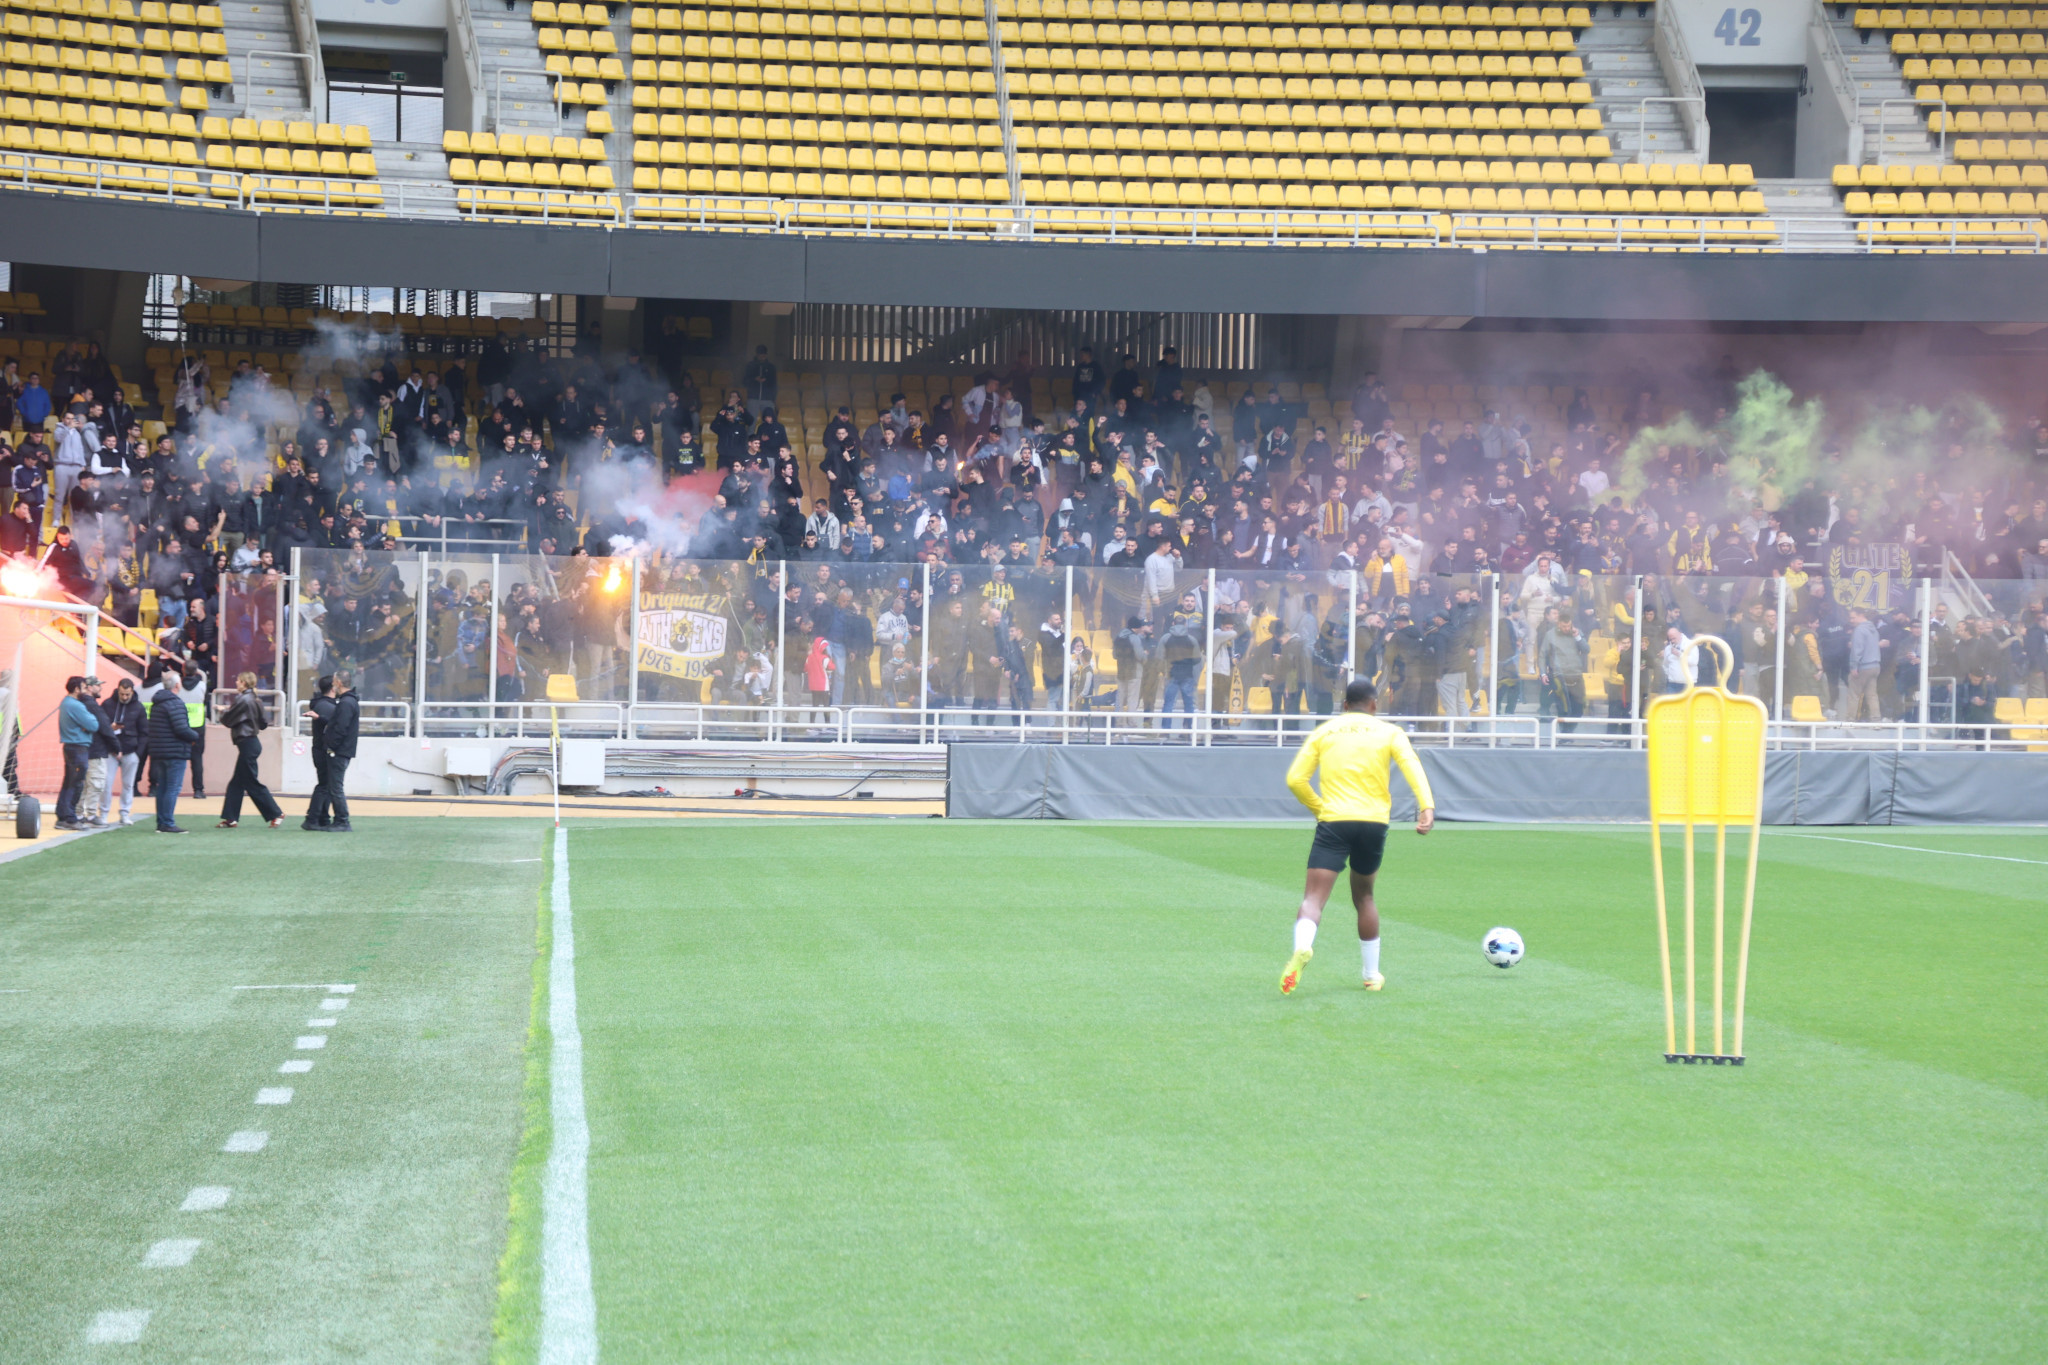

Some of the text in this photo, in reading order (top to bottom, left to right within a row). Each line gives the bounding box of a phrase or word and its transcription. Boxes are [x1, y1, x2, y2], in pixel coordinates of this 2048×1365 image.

[1714, 8, 1762, 46] 42
[1842, 543, 1900, 569] GATE
[640, 591, 709, 612] Original
[1852, 568, 1890, 610] 21
[639, 647, 674, 672] 1975
[684, 657, 720, 678] 198
